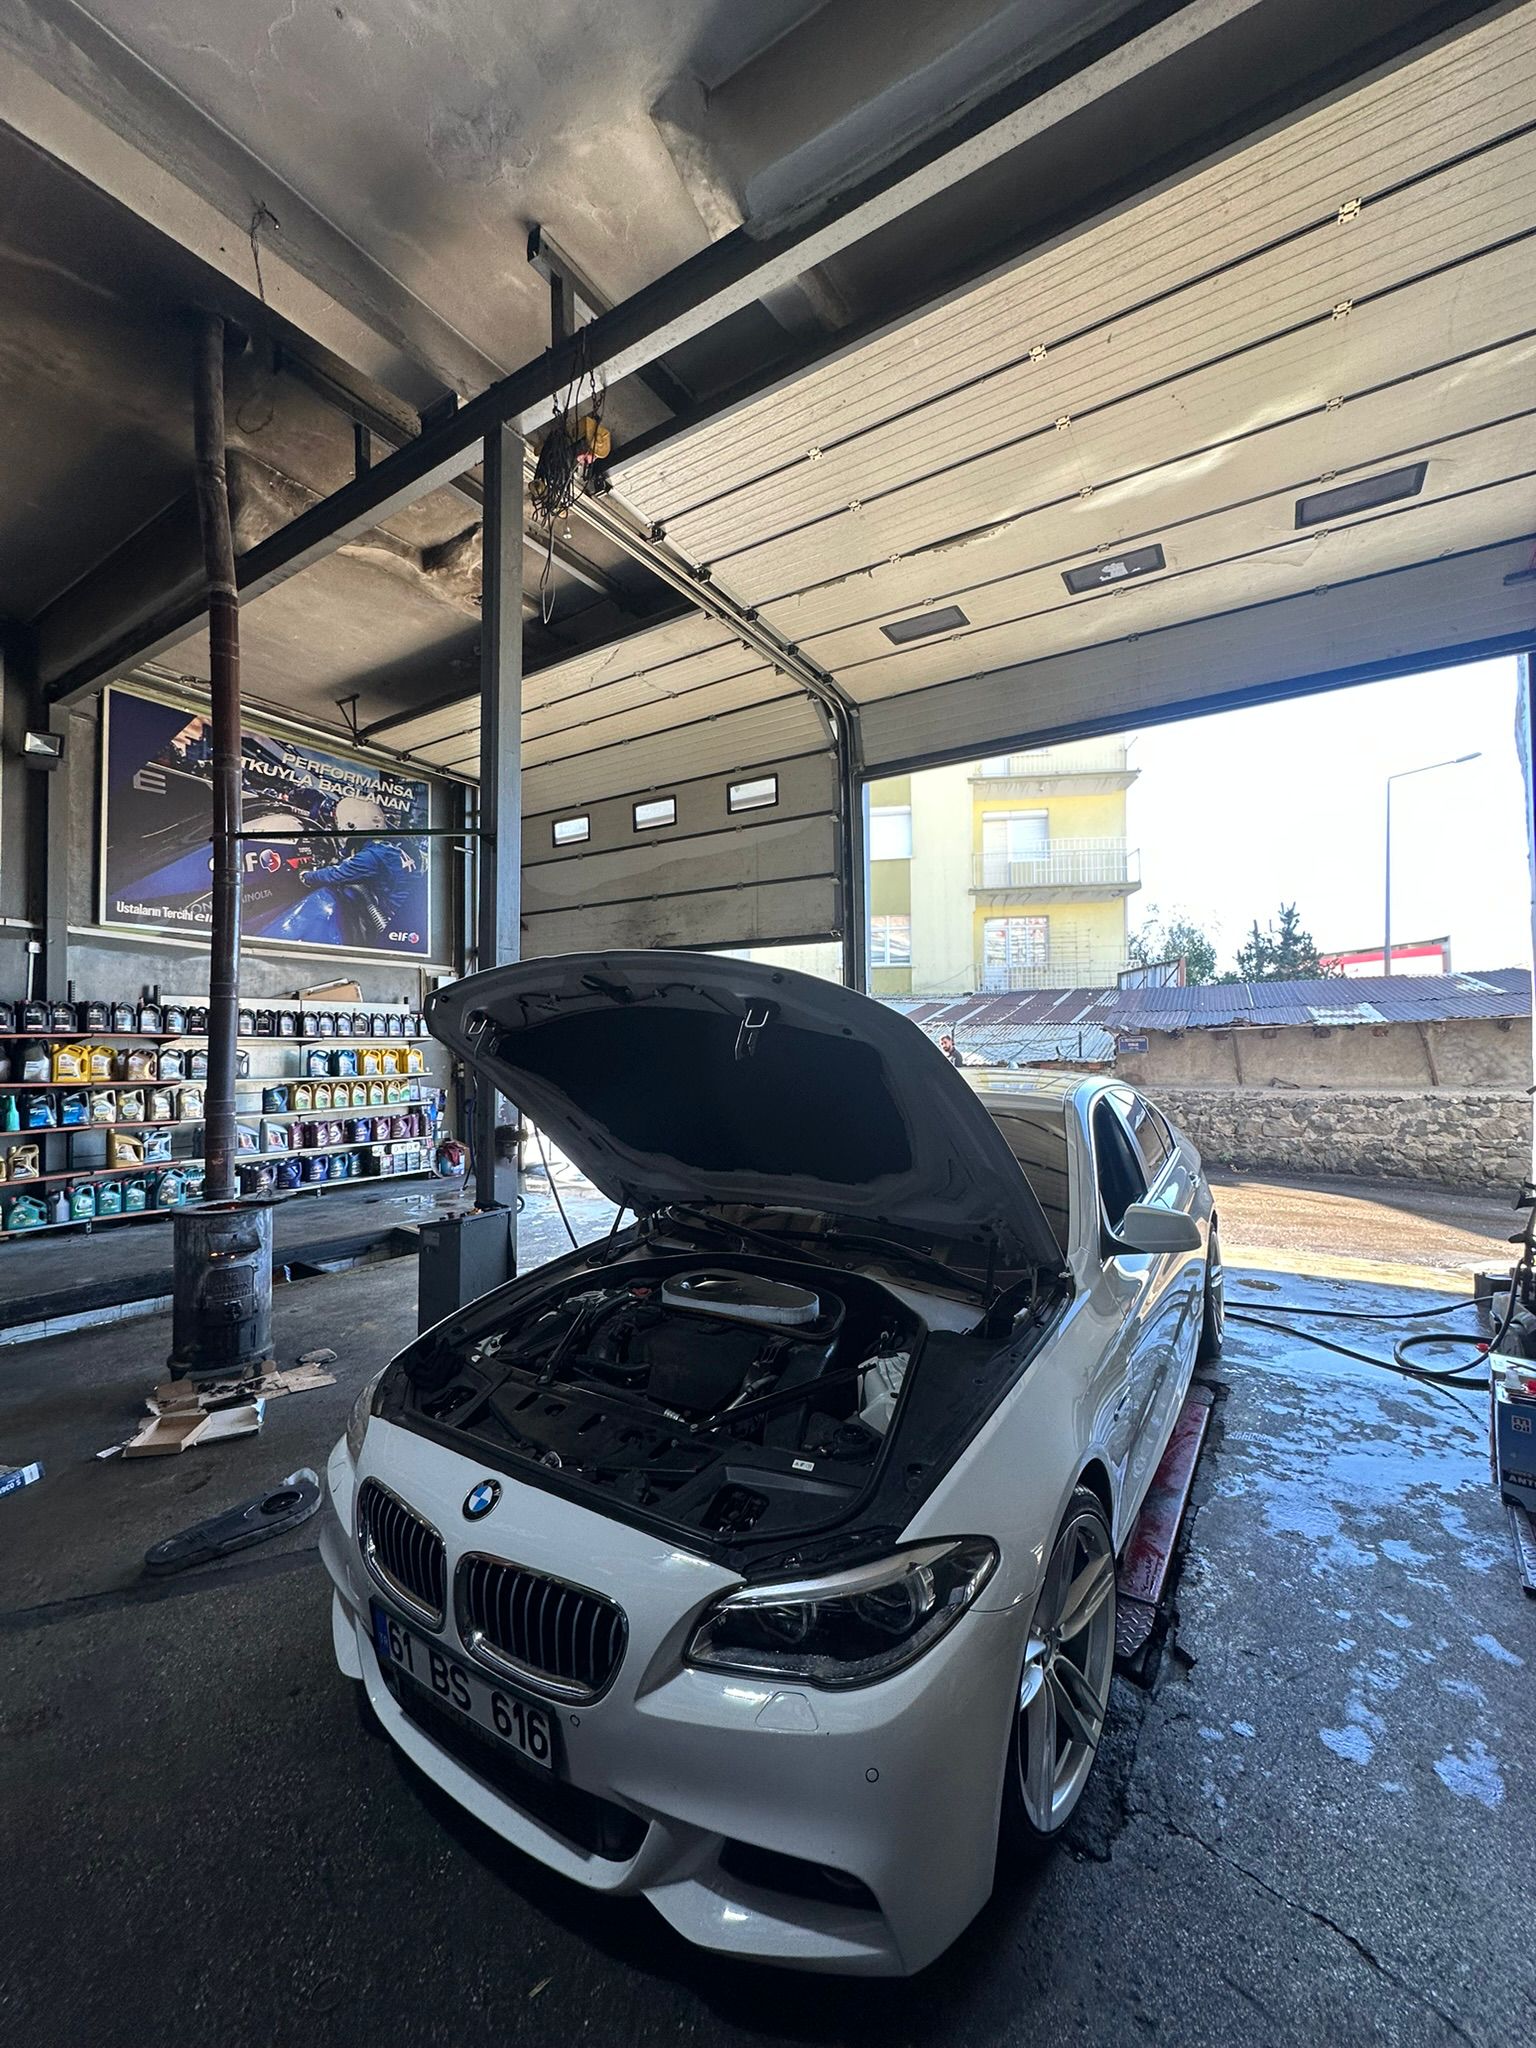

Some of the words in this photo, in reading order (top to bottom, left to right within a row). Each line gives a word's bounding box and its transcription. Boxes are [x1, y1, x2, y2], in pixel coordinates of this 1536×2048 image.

[282, 752, 414, 799] PERFORMANSA
[319, 779, 411, 812] BAĞLANAN
[162, 906, 193, 921] Tercihi
[388, 1620, 414, 1673] 61
[429, 1648, 472, 1711] BS
[491, 1690, 549, 1760] 616
